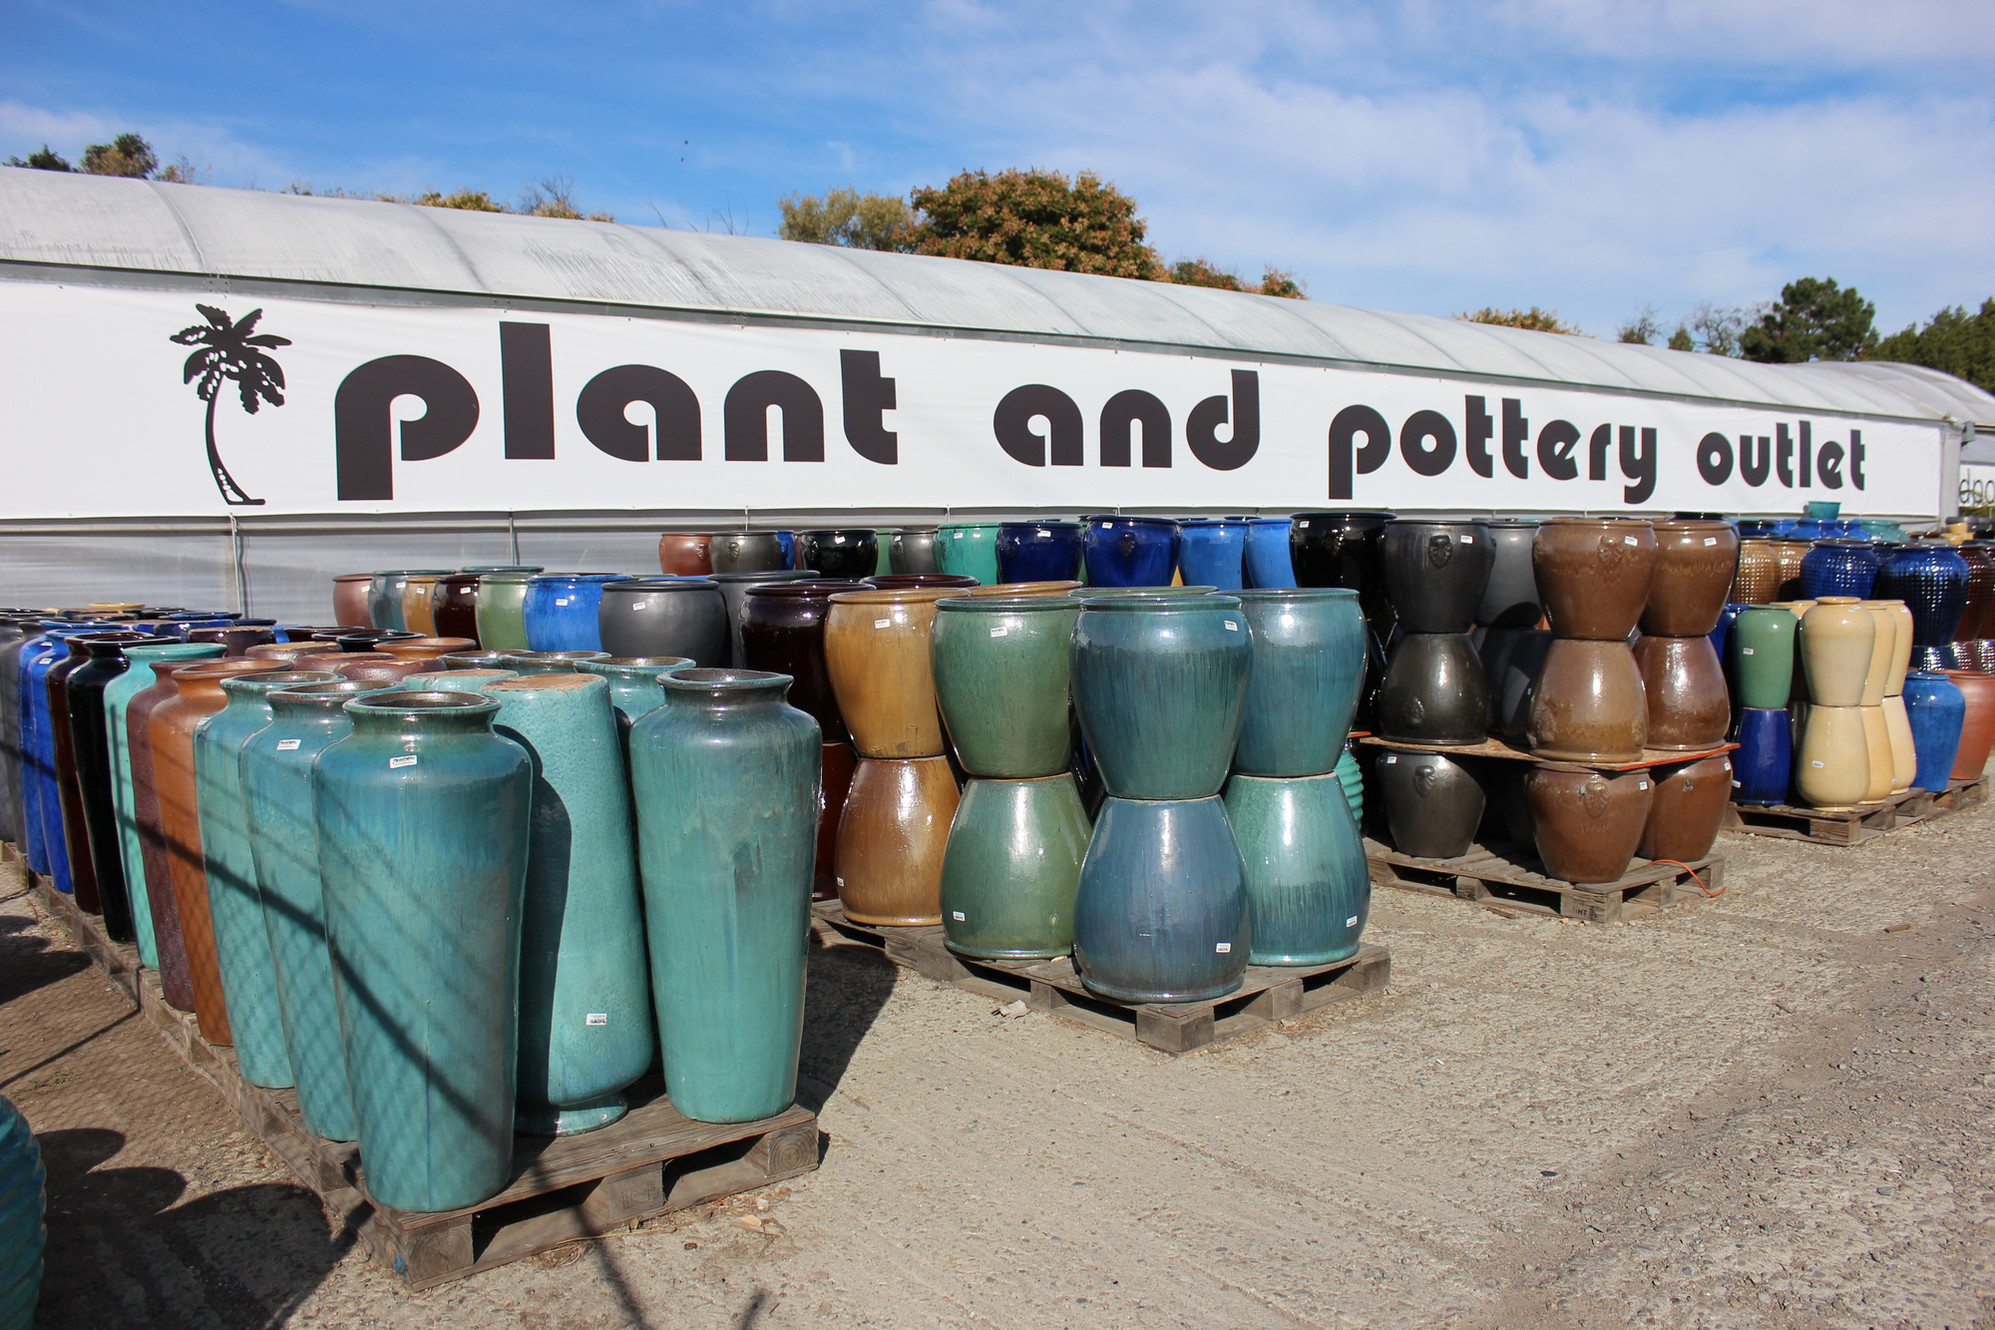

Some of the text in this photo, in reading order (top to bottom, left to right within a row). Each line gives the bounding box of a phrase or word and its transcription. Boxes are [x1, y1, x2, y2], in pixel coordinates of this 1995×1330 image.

[334, 321, 1865, 505] plant and pottery outlet
